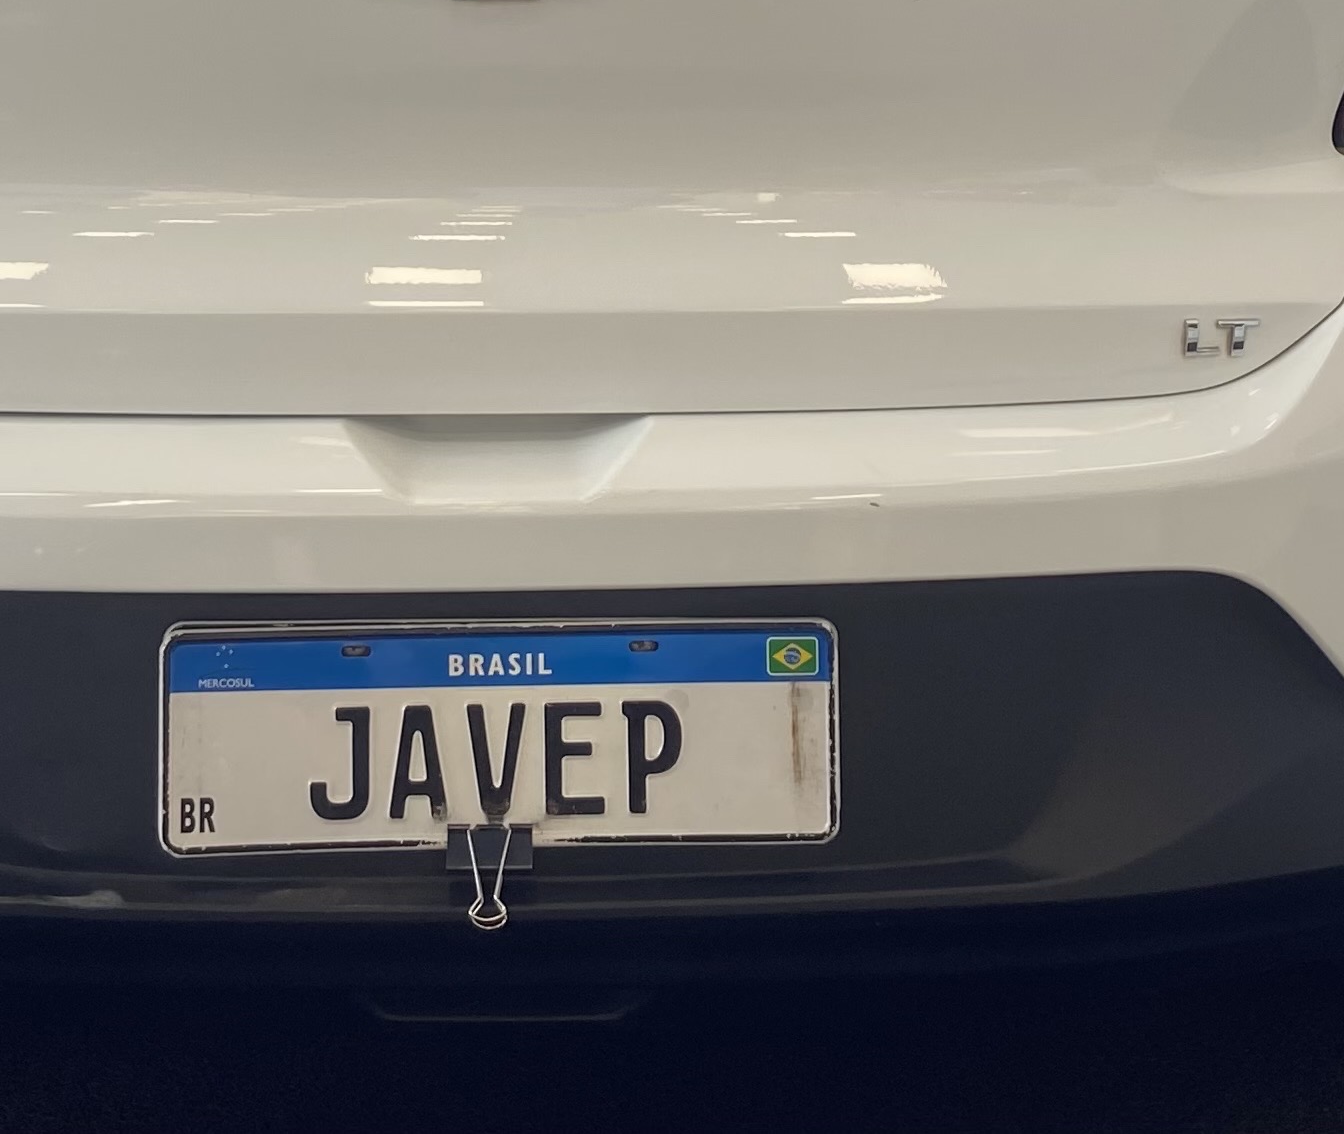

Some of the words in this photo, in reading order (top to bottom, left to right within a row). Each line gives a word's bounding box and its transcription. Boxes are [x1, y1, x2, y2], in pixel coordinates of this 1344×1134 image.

[1183, 318, 1260, 357] LT
[448, 653, 553, 677] BRASIL
[198, 678, 255, 689] MERCOSUL
[309, 701, 683, 821] JAVEP
[180, 797, 216, 833] BR
